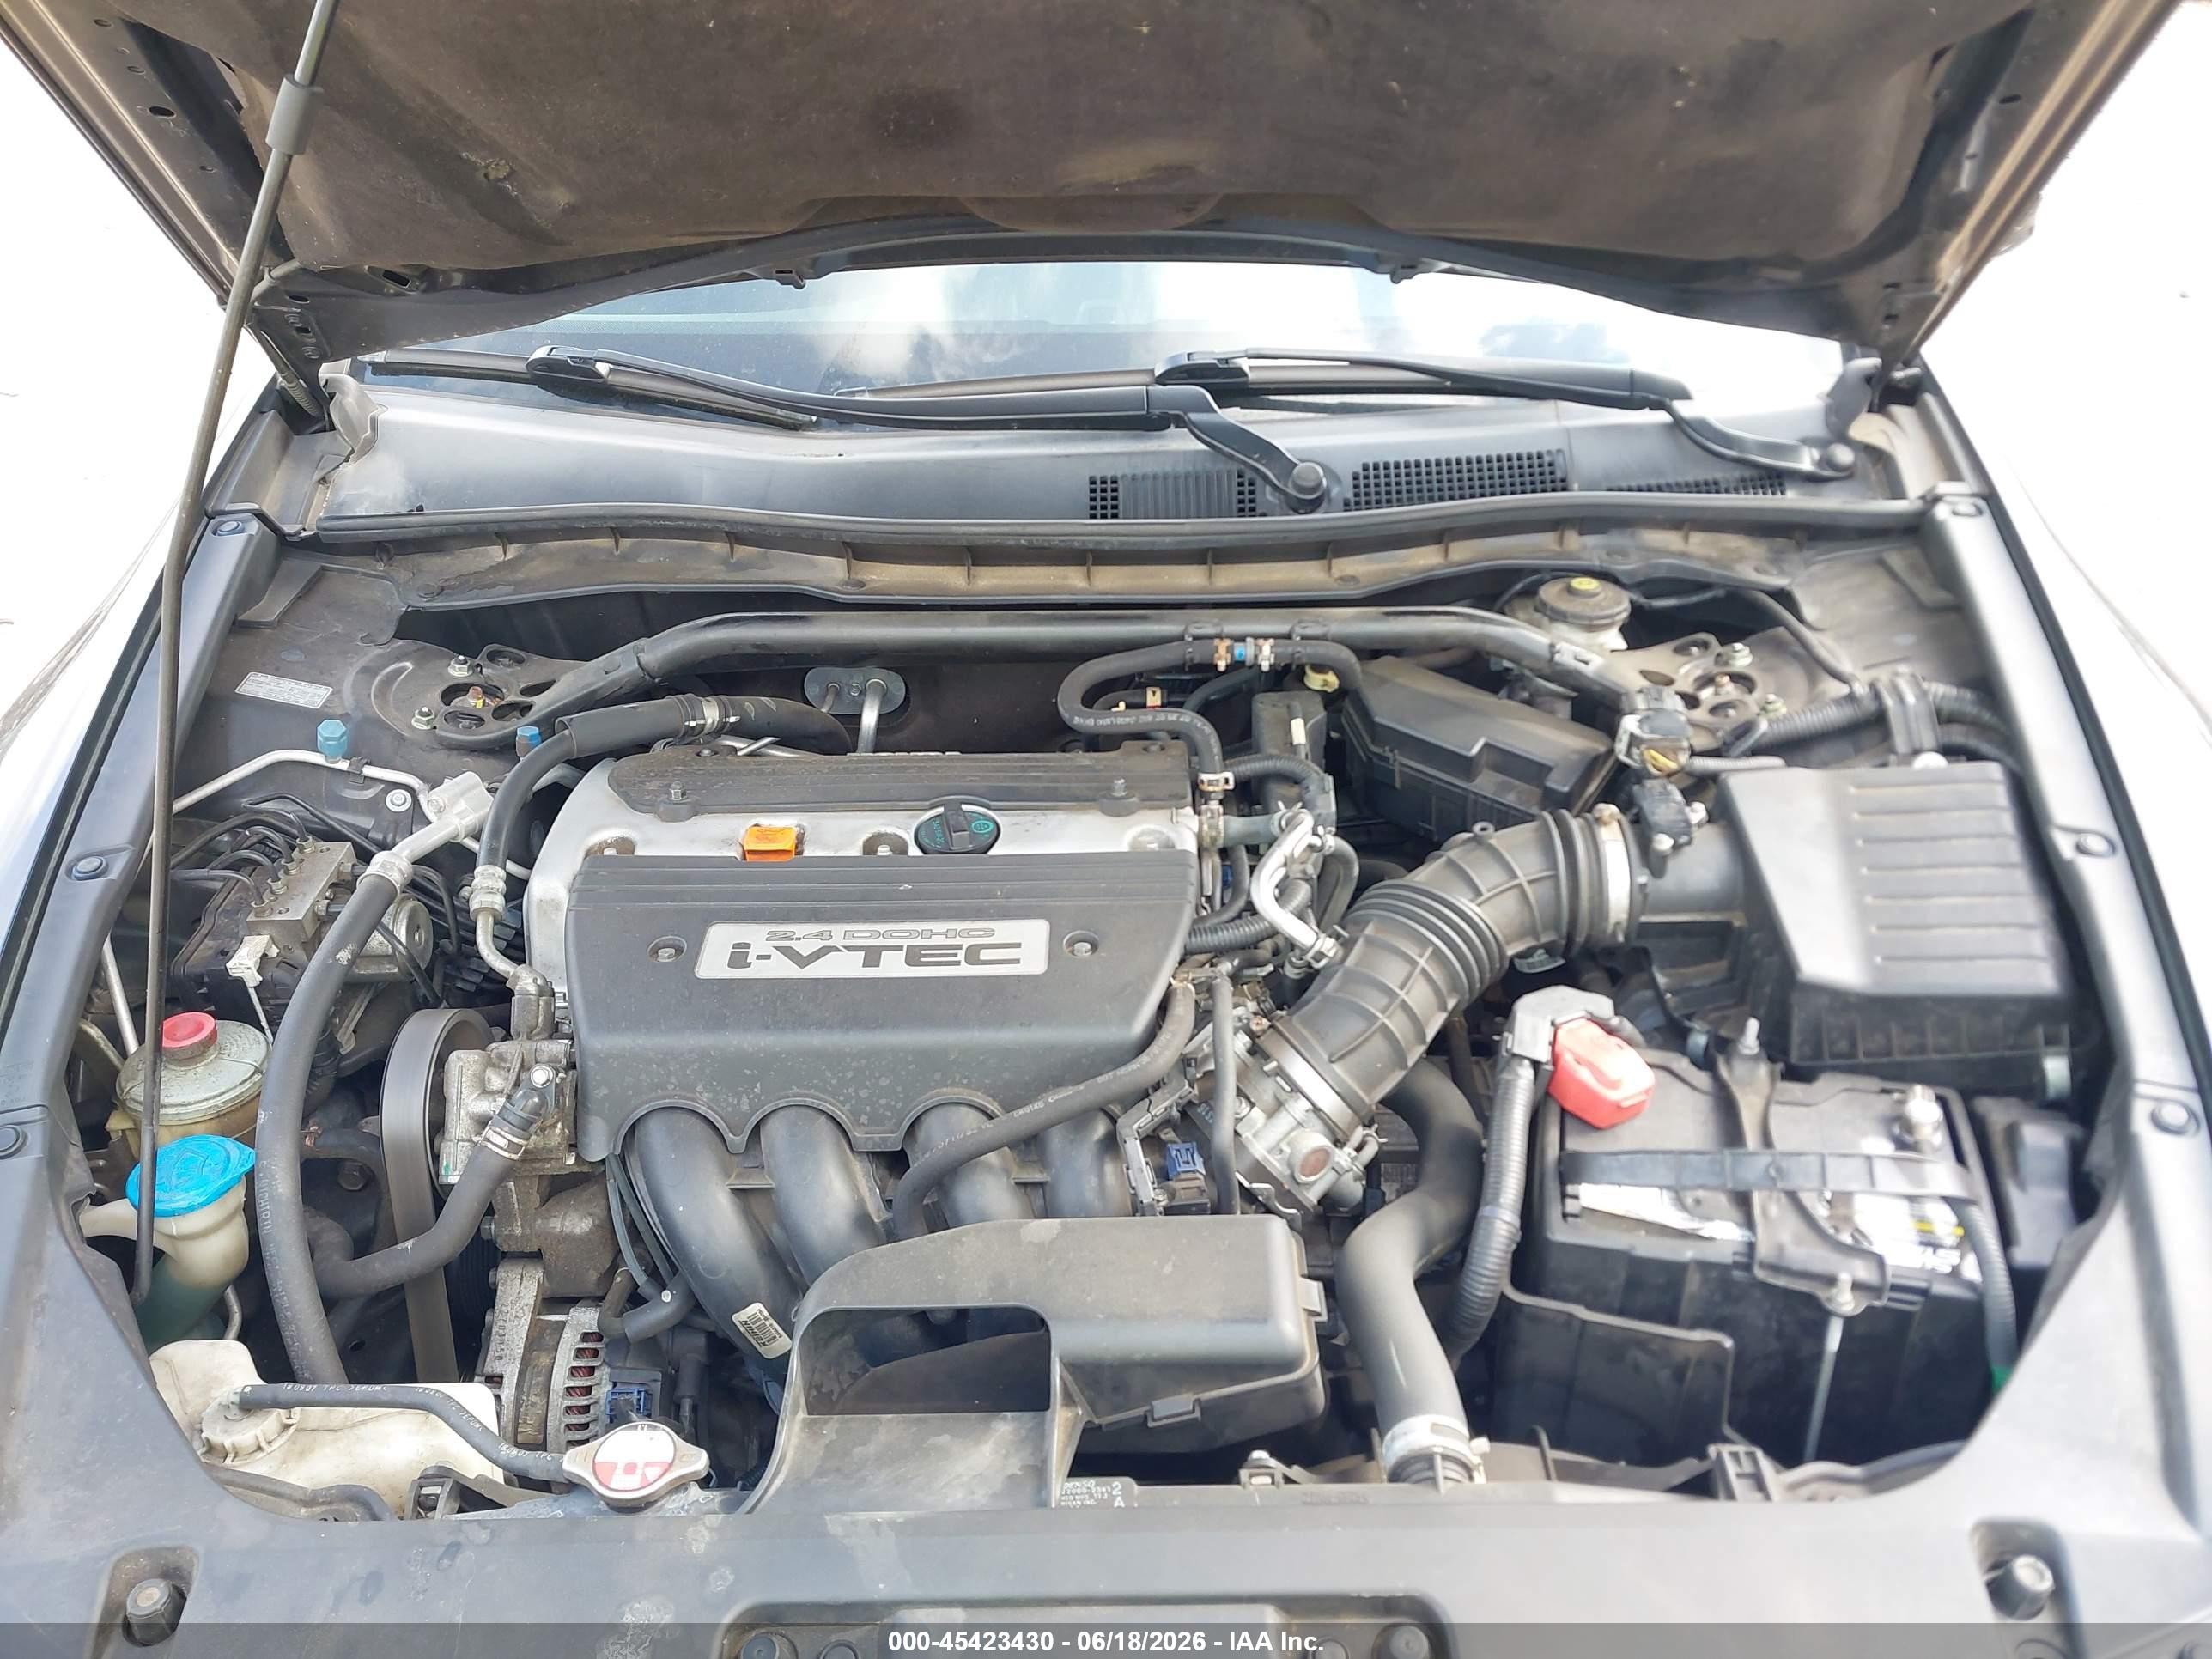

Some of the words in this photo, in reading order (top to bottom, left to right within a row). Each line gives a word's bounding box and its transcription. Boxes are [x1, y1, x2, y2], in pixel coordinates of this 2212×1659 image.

[766, 929, 833, 941] 2.4
[843, 927, 995, 940] DOHC
[727, 941, 1022, 969] i-VTEC
[741, 1320, 769, 1347] KEIHIN
[1112, 1481, 1121, 1495] 2
[1114, 1496, 1125, 1508] A
